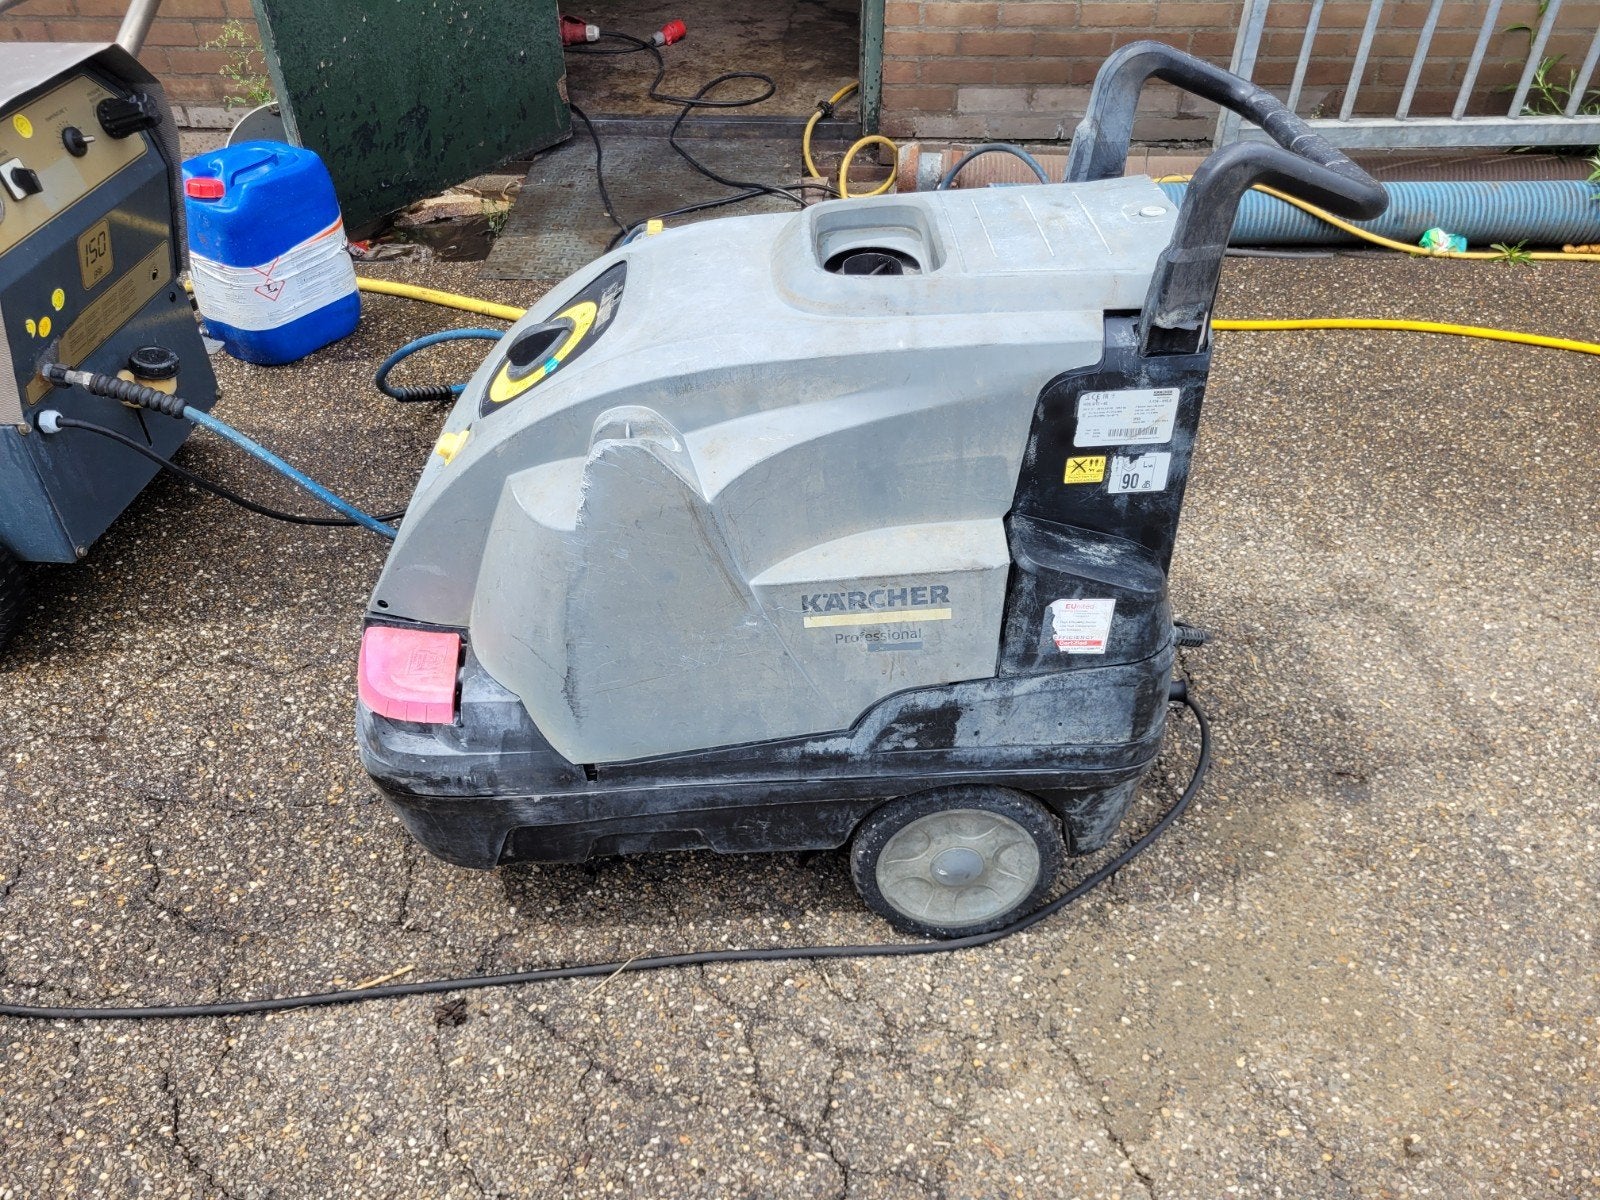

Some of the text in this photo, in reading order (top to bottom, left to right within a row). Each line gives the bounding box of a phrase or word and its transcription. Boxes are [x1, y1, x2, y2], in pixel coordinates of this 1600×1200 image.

[86, 230, 106, 267] 150
[1121, 473, 1139, 489] 90
[802, 585, 949, 612] KÄRCHER
[835, 628, 922, 644] Professional
